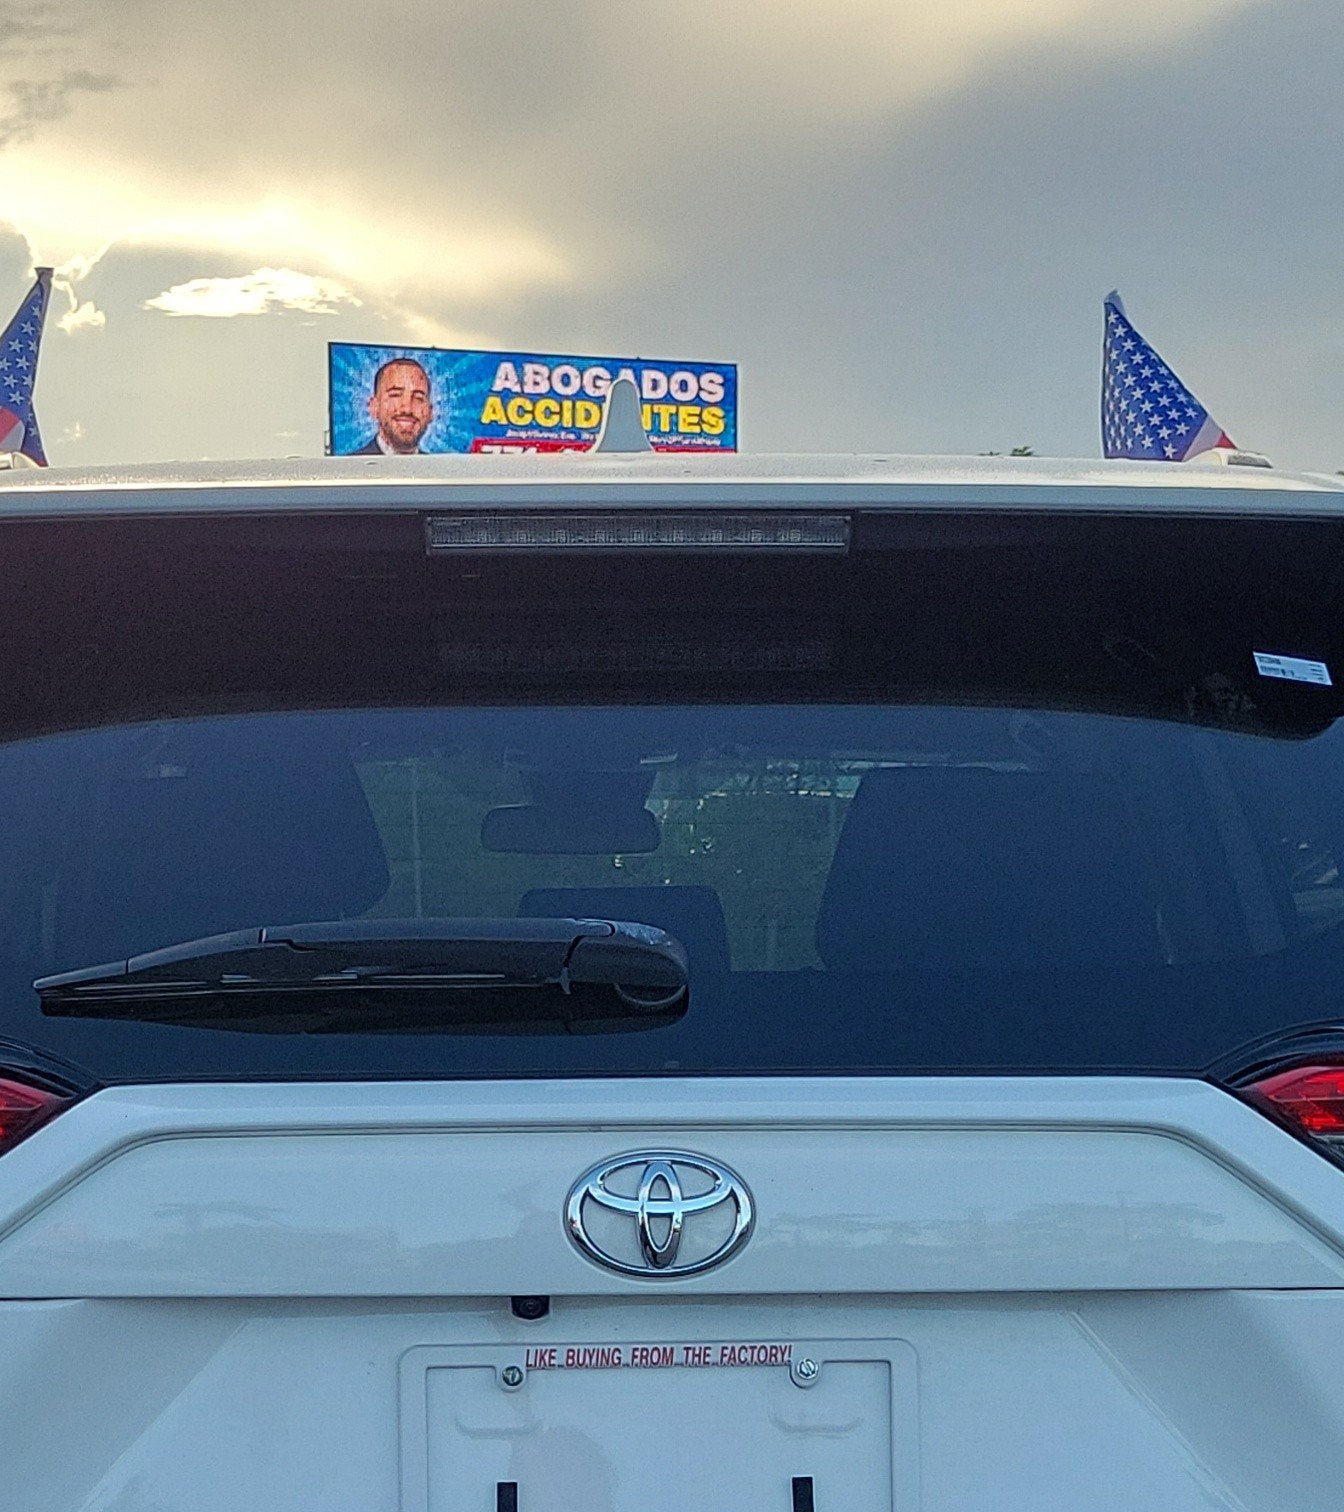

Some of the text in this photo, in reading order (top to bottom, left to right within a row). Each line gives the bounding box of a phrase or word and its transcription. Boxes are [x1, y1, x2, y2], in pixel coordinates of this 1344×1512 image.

[480, 395, 725, 434] ACCIDTES
[525, 1344, 792, 1368] LIKE BUYING FROM THE FACTORY!
